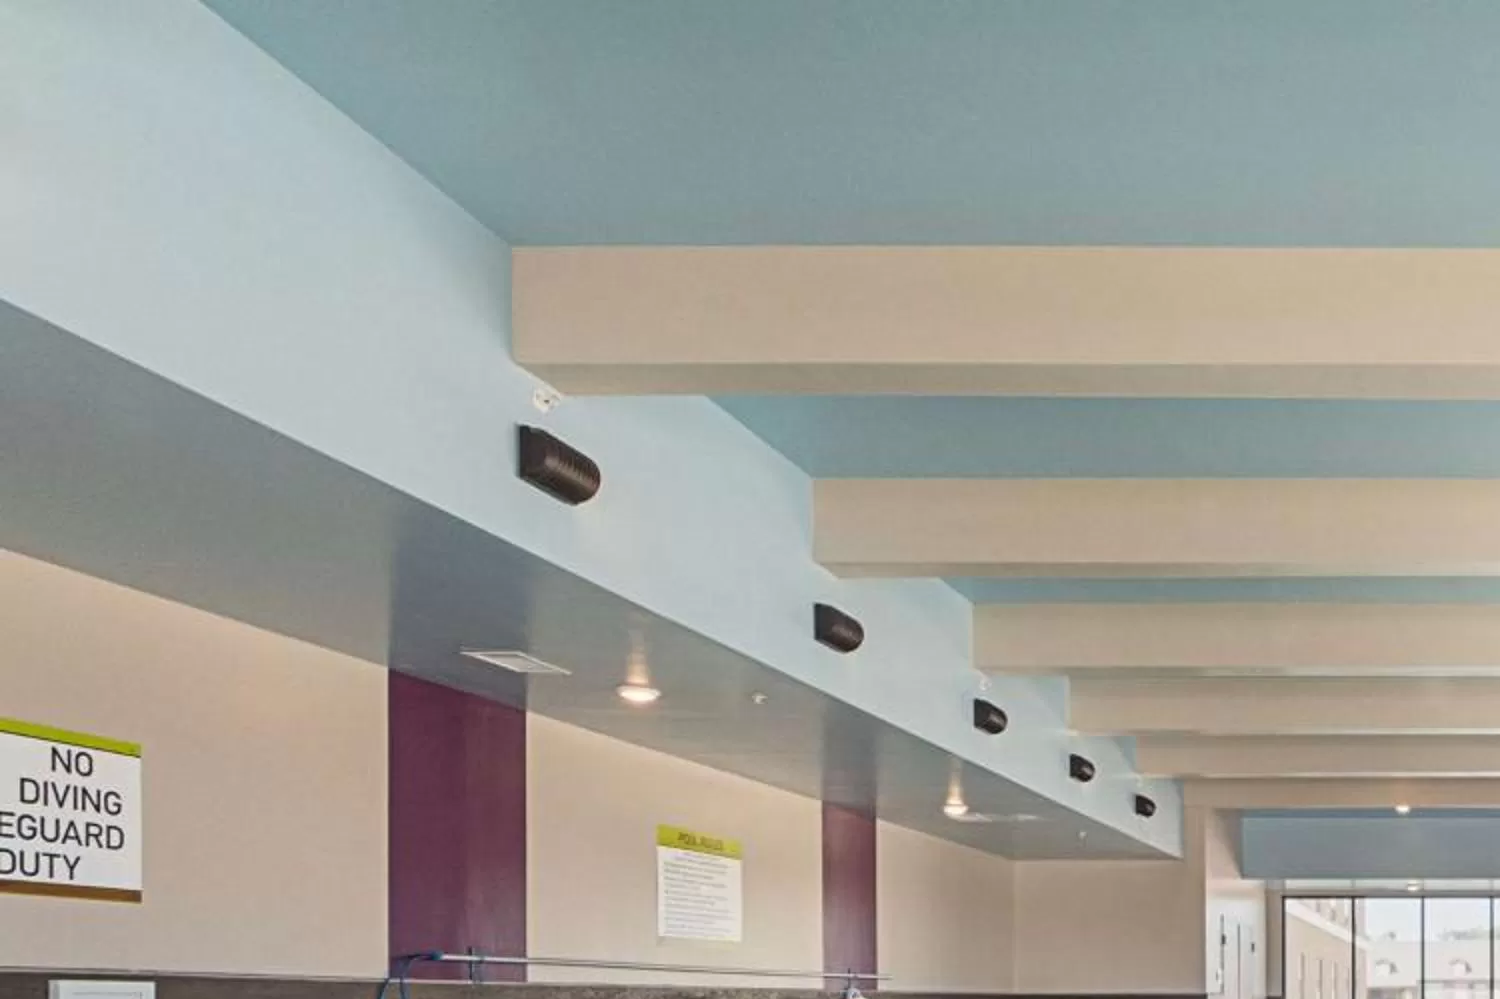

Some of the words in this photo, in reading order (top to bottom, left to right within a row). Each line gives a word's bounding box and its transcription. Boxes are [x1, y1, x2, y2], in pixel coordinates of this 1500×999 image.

[51, 746, 93, 777] NO
[20, 777, 122, 815] DIVING
[0, 848, 81, 880] DUTY
